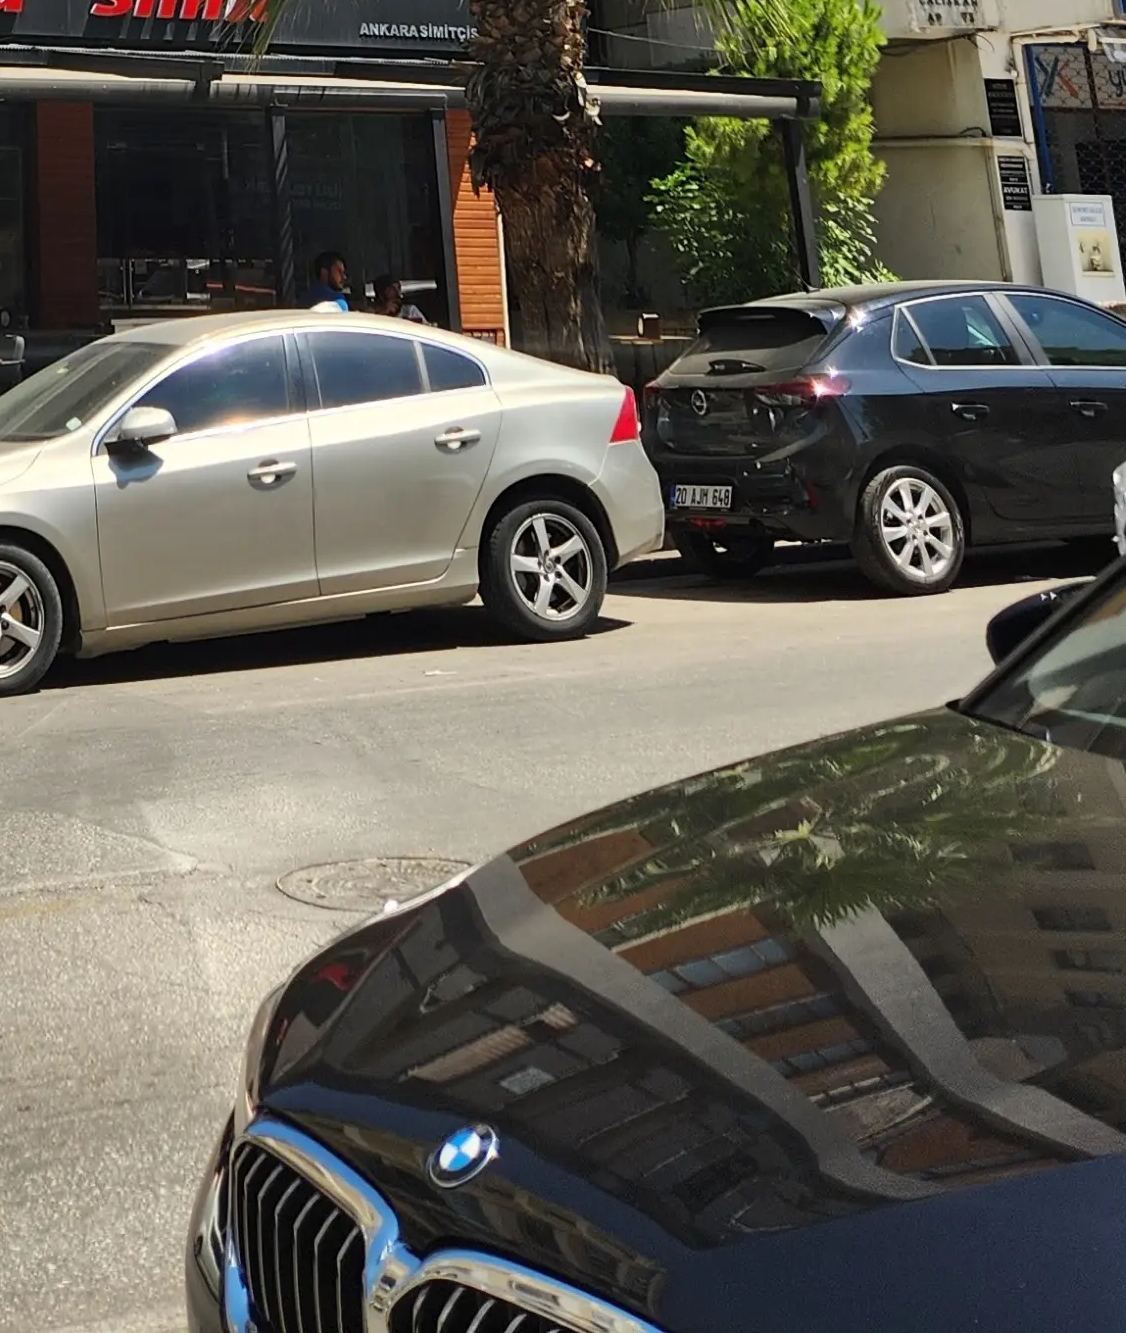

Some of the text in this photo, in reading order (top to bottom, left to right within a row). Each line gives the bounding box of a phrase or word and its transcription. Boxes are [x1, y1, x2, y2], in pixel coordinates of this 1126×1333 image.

[359, 22, 480, 42] ANKARA SİMİTÇİS
[676, 487, 687, 505] 20
[712, 488, 730, 506] 648
